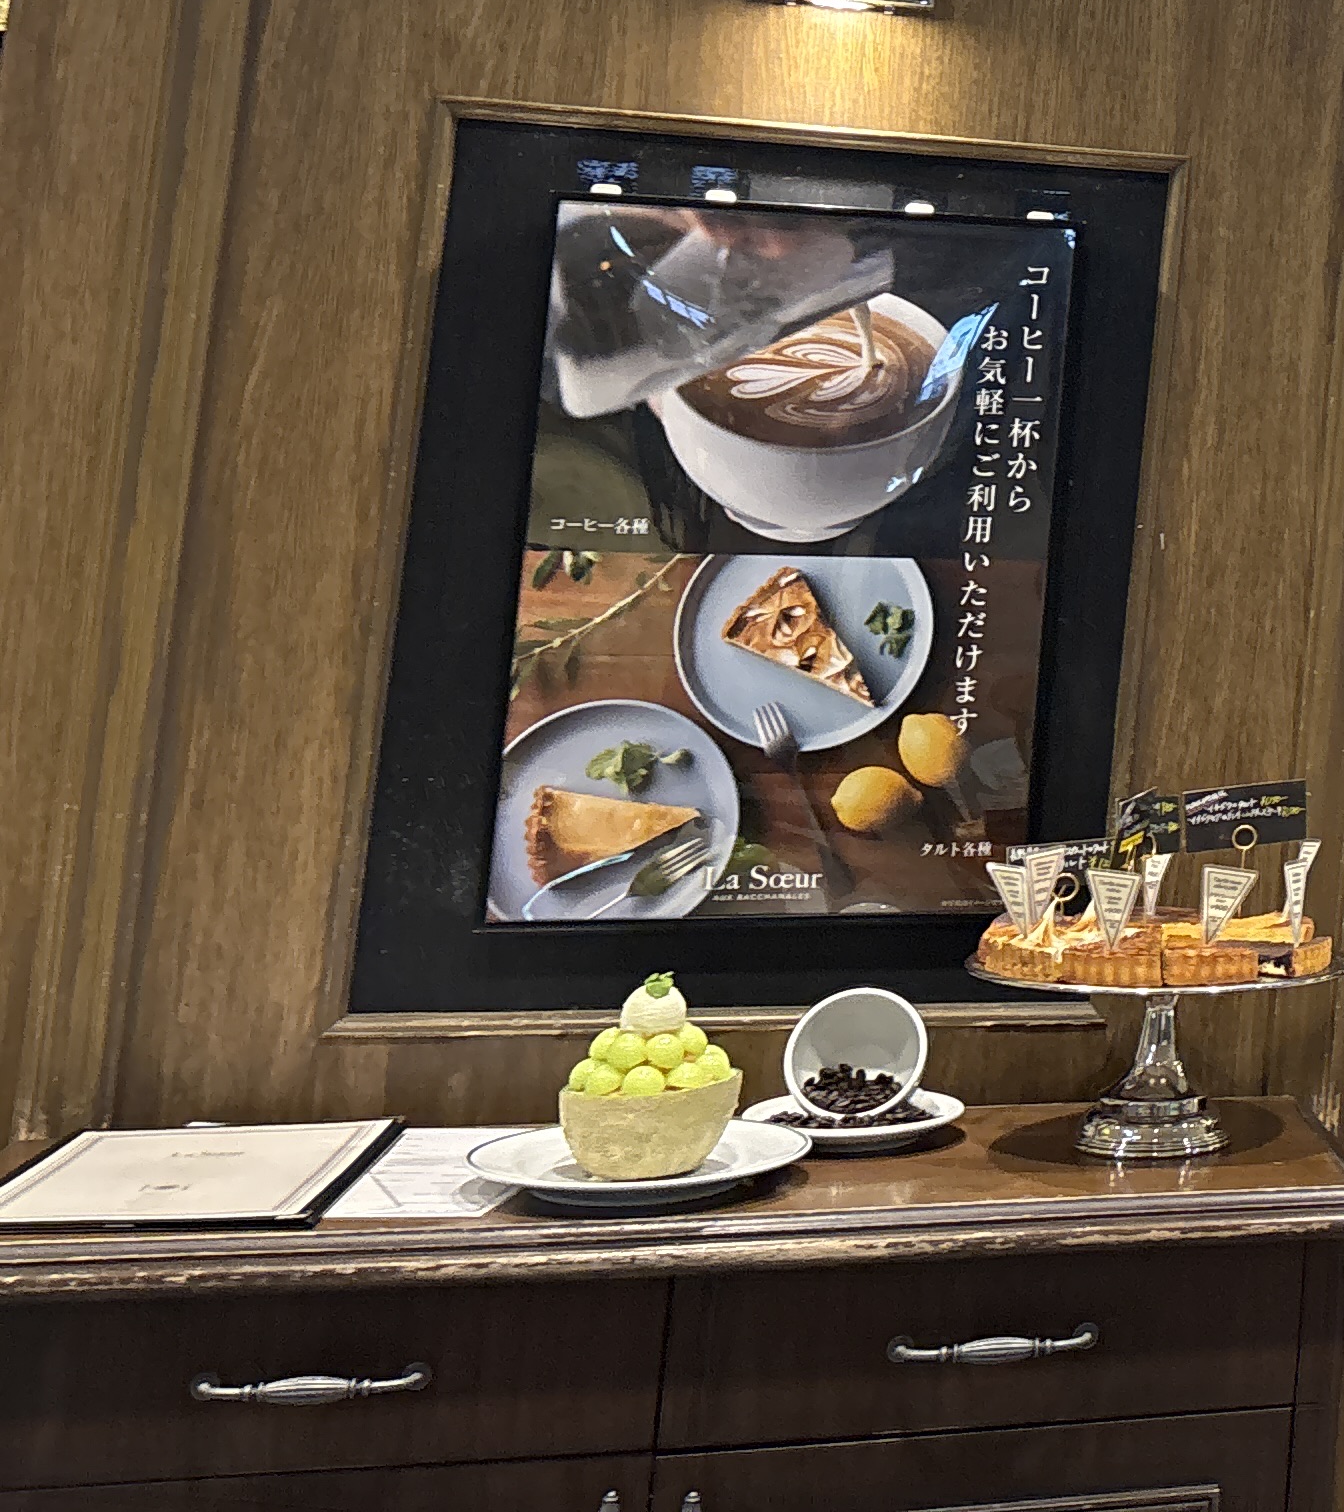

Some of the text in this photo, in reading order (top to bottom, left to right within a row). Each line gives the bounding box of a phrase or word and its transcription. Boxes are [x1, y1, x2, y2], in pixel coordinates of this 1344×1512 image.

[1007, 266, 1050, 513] コーヒー一杯から
[550, 517, 650, 535] コーヒー各種
[950, 326, 1008, 736] お気軽にご利用いただけます
[920, 841, 993, 857] タルト各種
[704, 864, 823, 890] La Sœur
